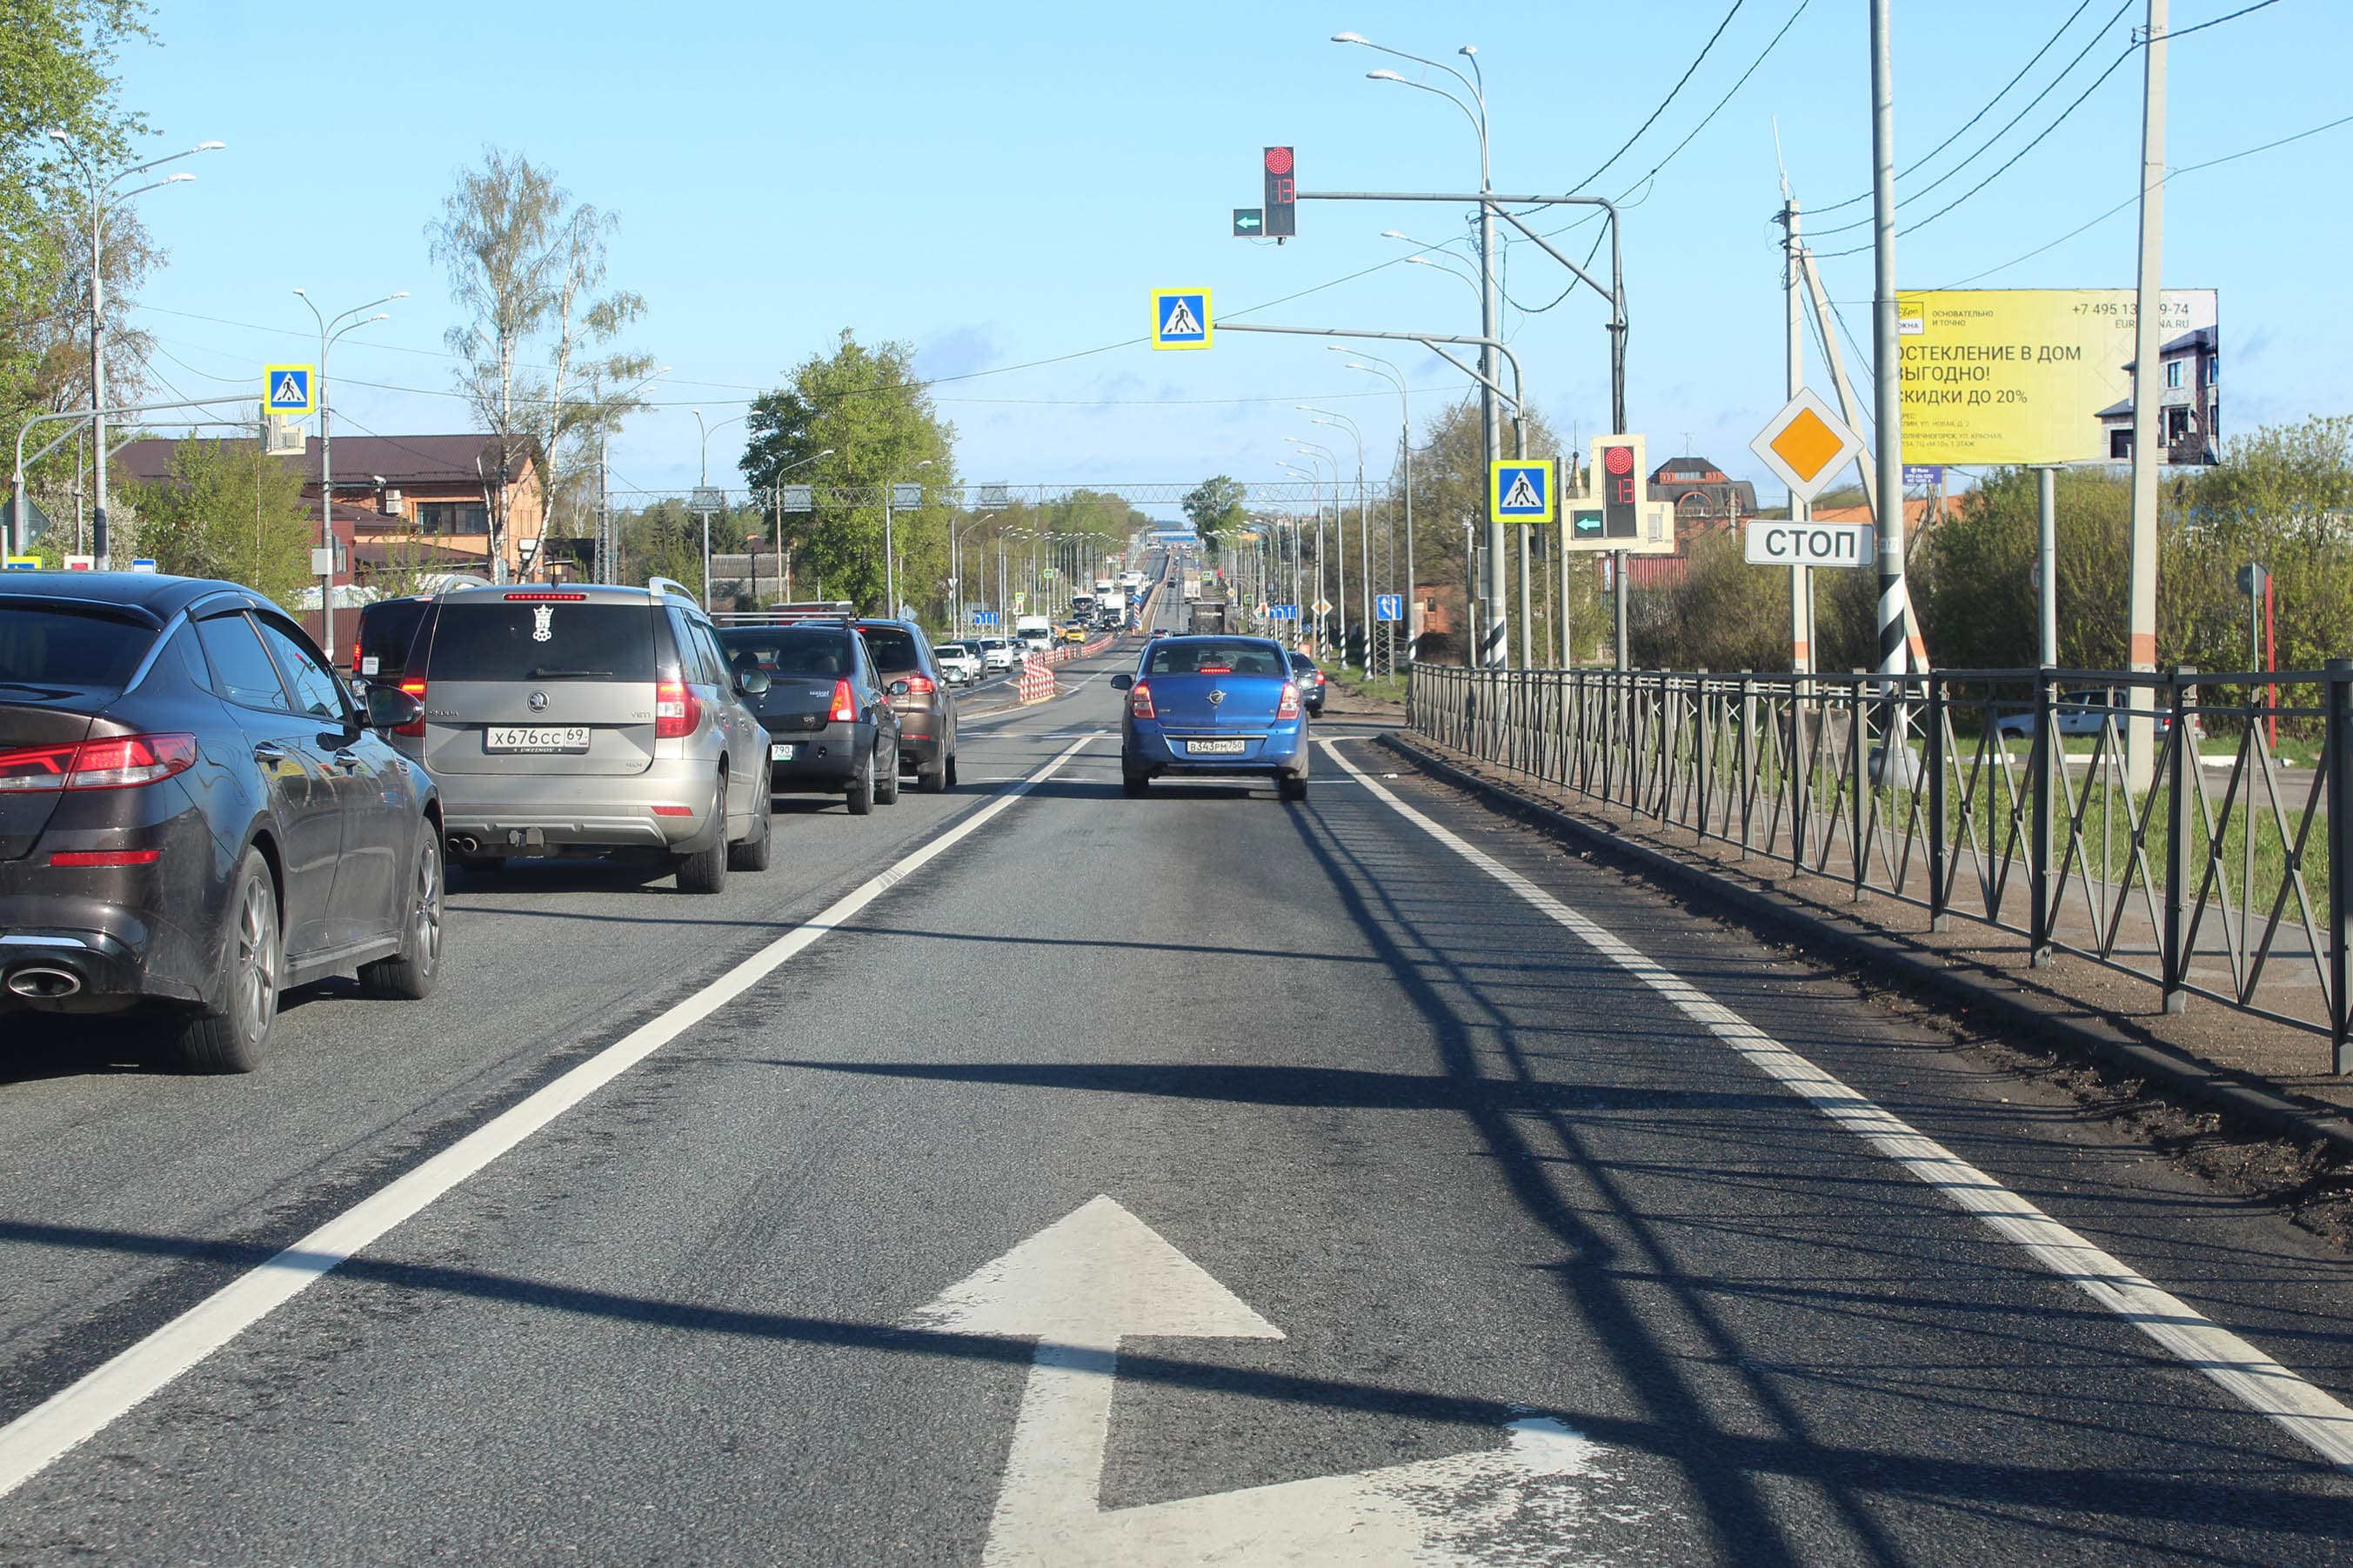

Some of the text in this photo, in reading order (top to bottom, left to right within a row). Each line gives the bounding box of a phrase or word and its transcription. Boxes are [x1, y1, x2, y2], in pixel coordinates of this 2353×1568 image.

[1278, 179, 1293, 203] 13
[2072, 304, 2089, 315] +7
[2093, 304, 2117, 315] 495
[2116, 319, 2189, 329] EURNA.RU
[2021, 346, 2032, 361] В
[2037, 346, 2082, 364] ДОМ
[1900, 390, 2029, 406] КИДКИ ДО 20%
[1619, 479, 1634, 503] 13
[1766, 529, 1855, 558] СТОП
[566, 729, 584, 740] 69
[774, 745, 790, 755] 790
